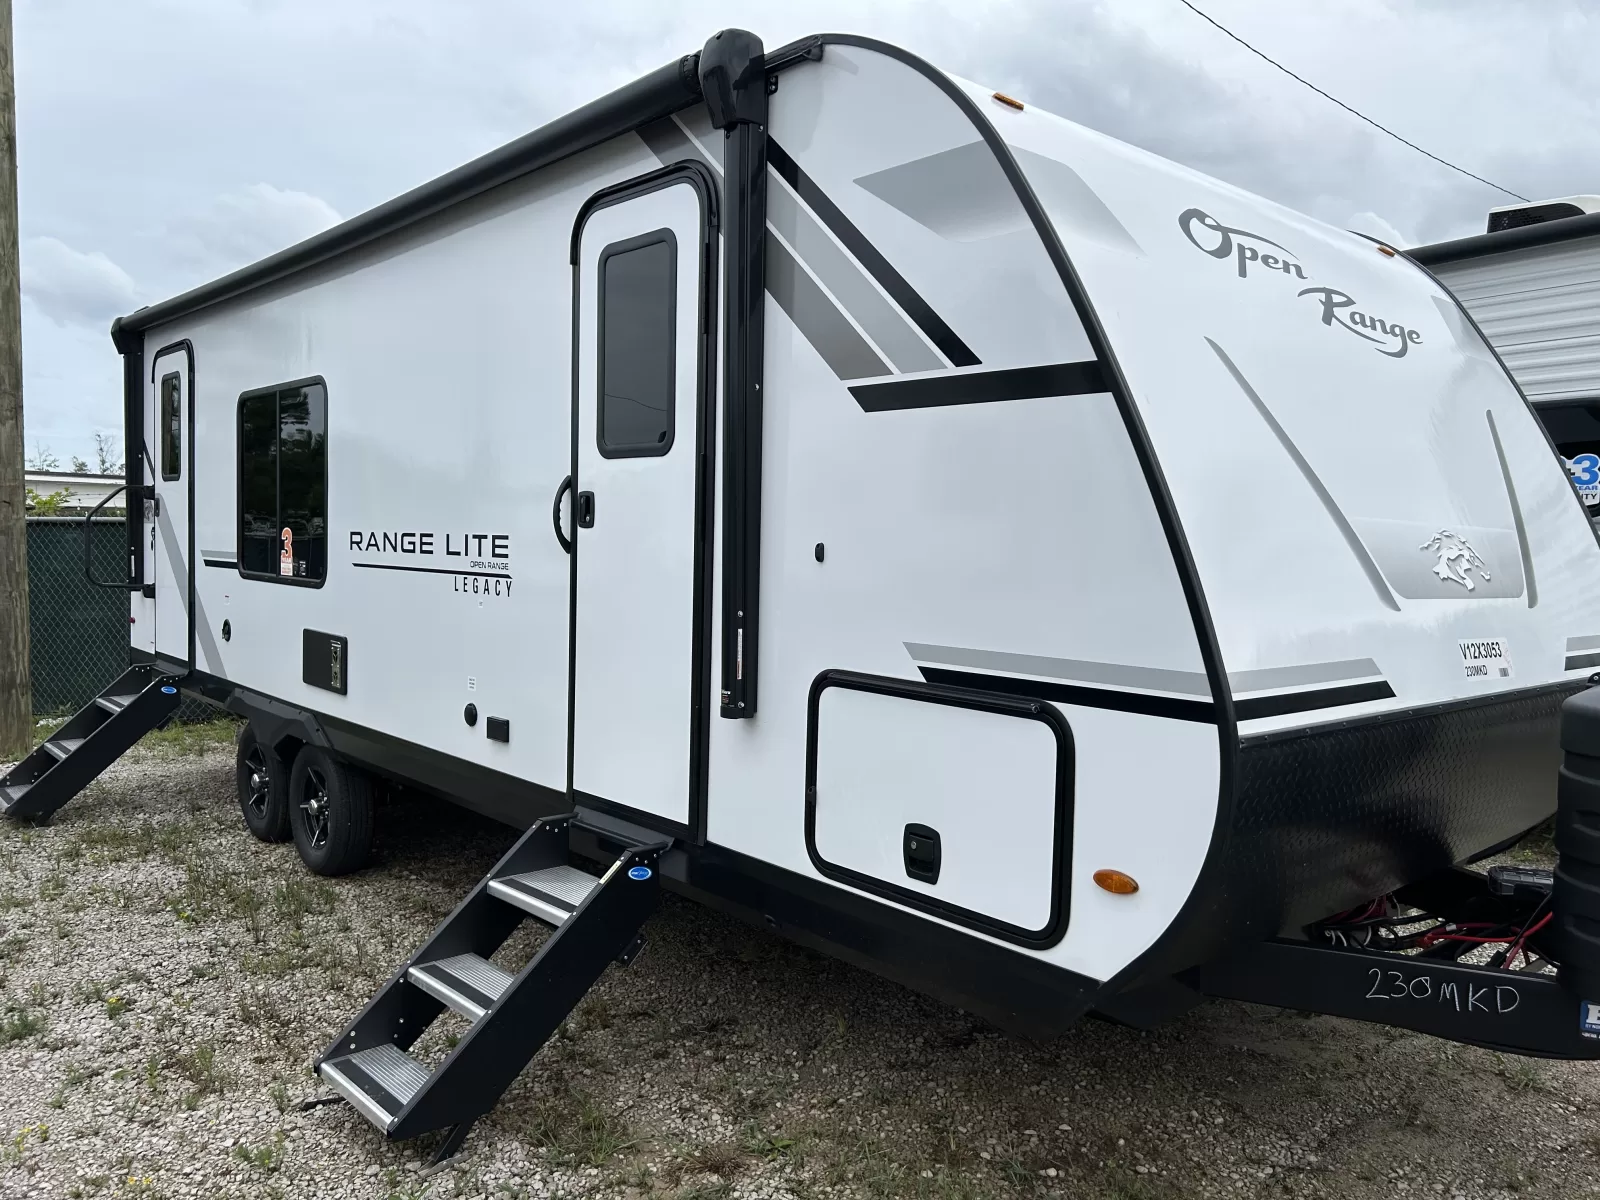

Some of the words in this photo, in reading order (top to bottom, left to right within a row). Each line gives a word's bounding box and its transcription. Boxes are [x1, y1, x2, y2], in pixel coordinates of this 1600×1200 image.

[1178, 208, 1308, 278] Open
[1297, 287, 1423, 358] Range
[349, 531, 434, 555] RANGE
[446, 533, 509, 558] LITE
[469, 560, 487, 569] OPEN
[487, 562, 509, 571] RANGE
[454, 575, 512, 598] LEGACY
[1459, 641, 1502, 660] V12X3053
[1465, 664, 1488, 677] 230MKD
[1365, 967, 1520, 1013] 230MKD
